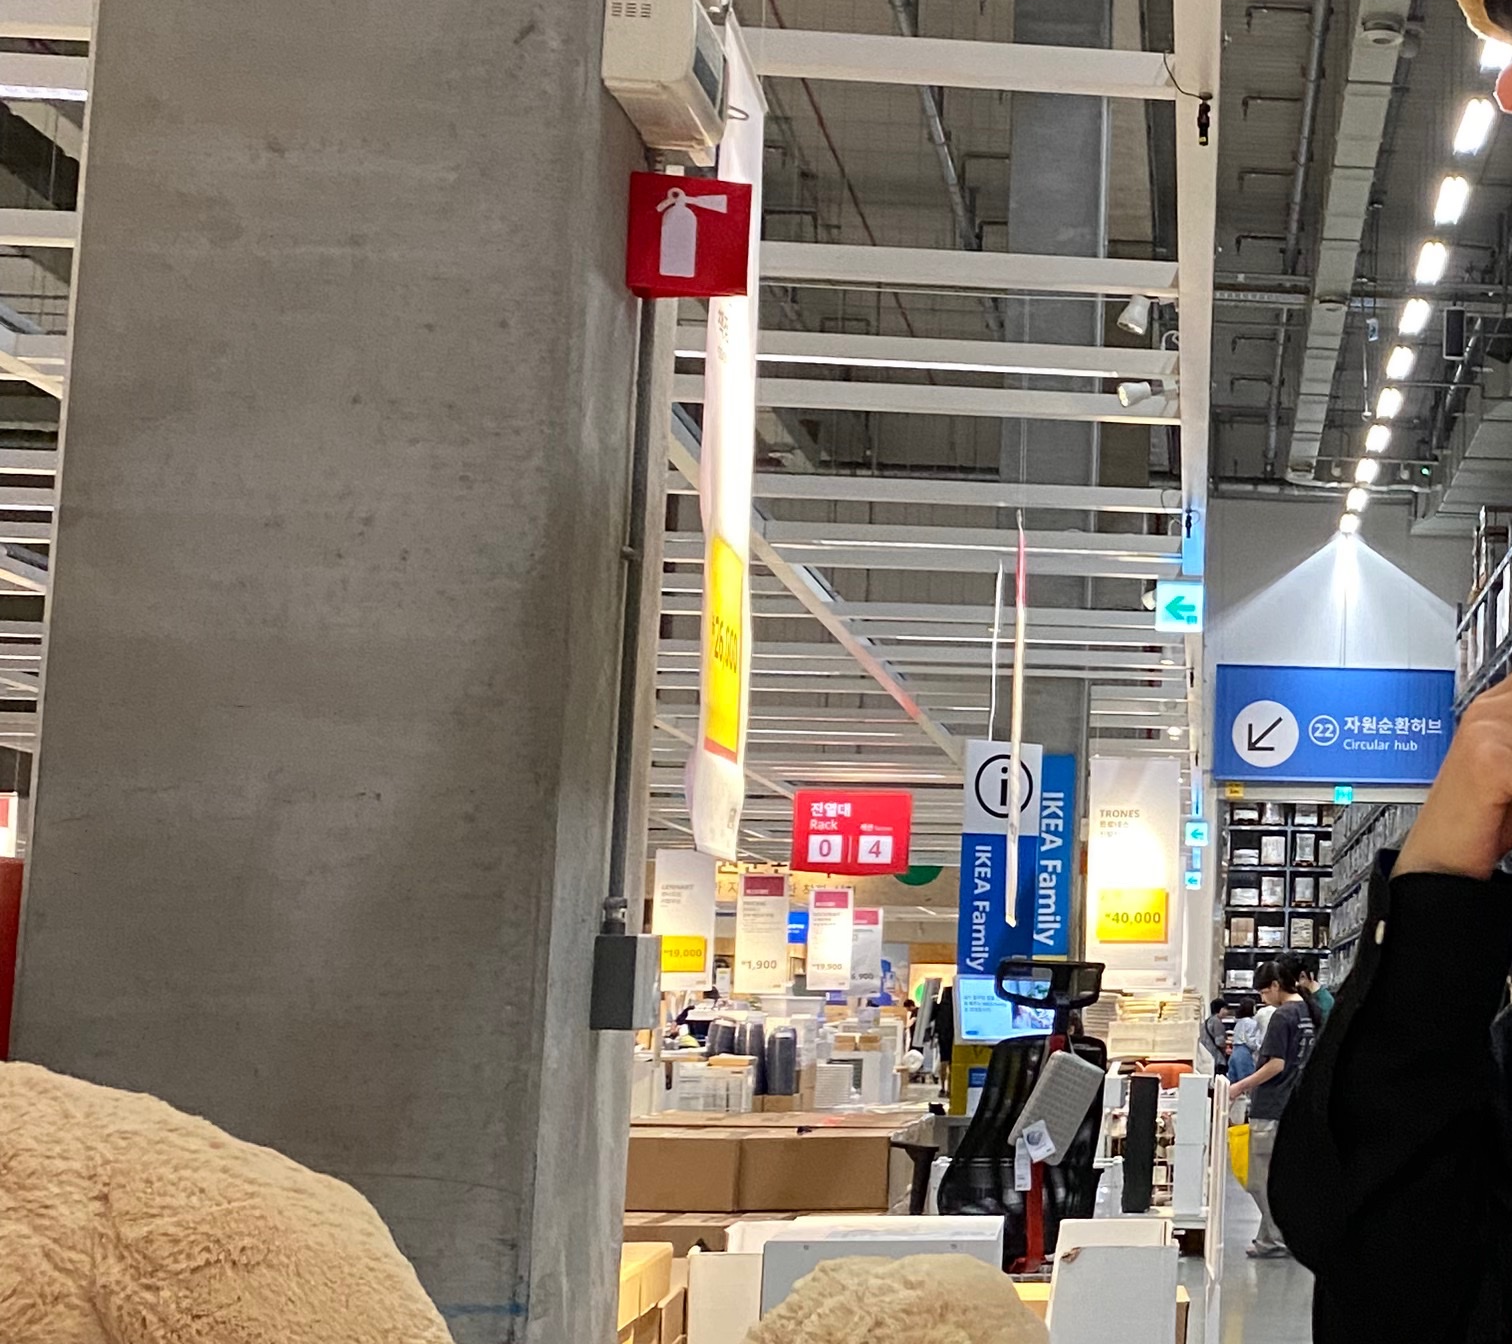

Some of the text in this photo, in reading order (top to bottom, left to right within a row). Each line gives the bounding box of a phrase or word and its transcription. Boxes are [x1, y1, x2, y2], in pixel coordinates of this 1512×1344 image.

[1313, 716, 1442, 738] 22 자원순환허브
[1343, 738, 1418, 752] Circular hub
[810, 802, 852, 818] 진열대
[1100, 809, 1141, 819] TRONES
[809, 819, 839, 831] Rack
[819, 839, 882, 858] 0 4
[974, 845, 992, 895] IKEA
[1033, 791, 1064, 946] IKEA Family
[966, 901, 990, 972] Family
